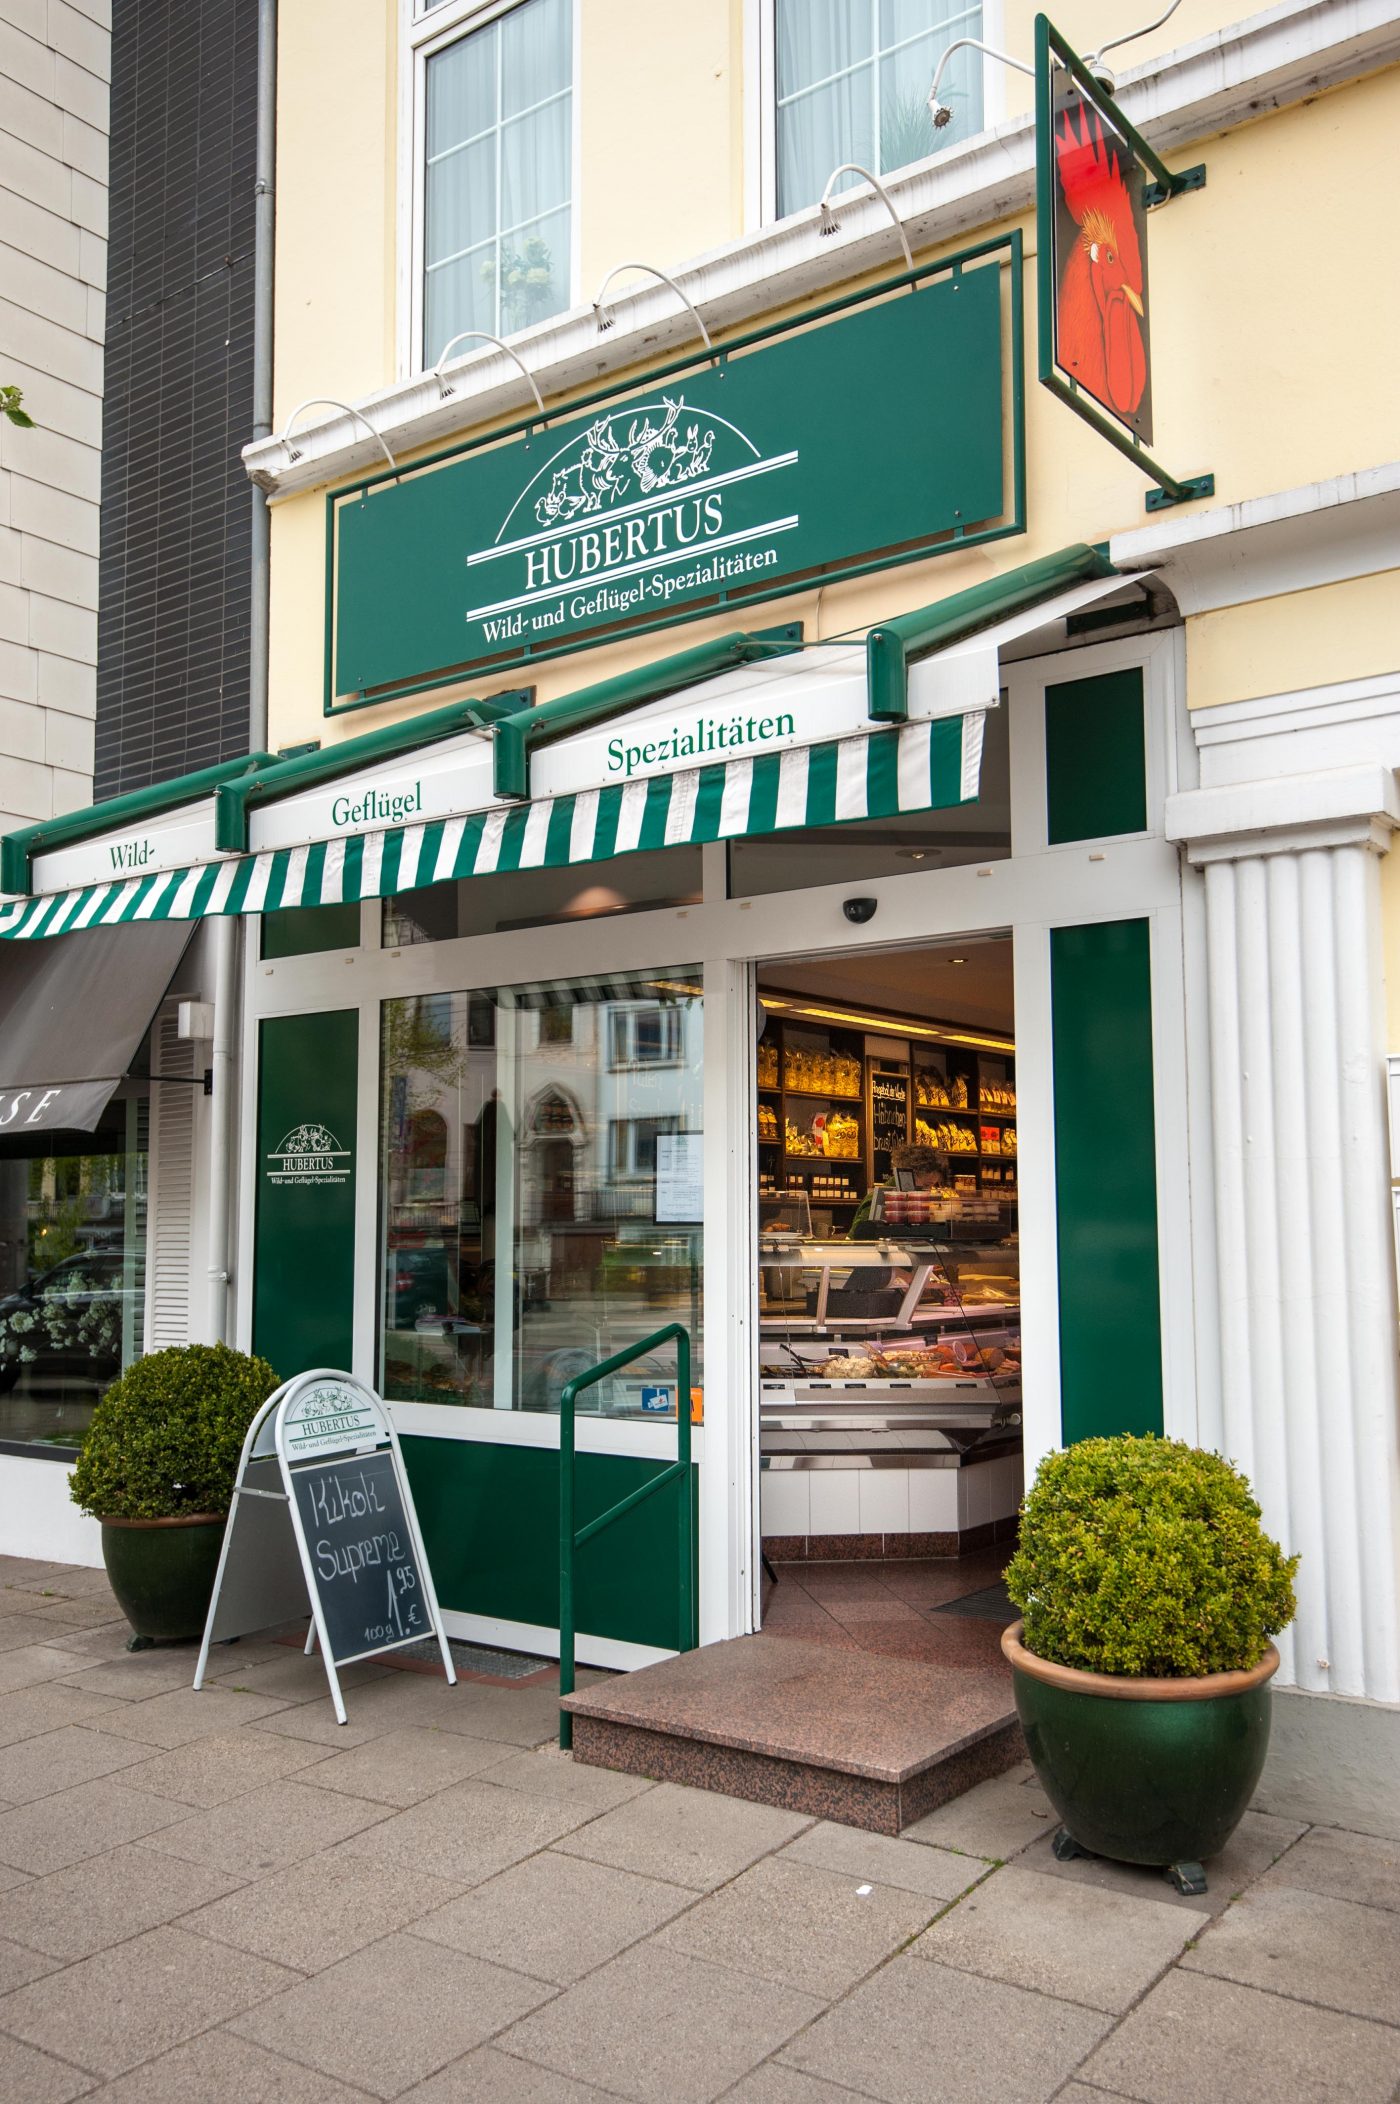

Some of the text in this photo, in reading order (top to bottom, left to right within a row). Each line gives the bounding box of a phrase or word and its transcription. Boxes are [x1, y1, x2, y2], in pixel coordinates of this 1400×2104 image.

[525, 493, 723, 590] HUBERTUS
[482, 549, 779, 643] Wild- und Geflügel-Spezialitäten
[607, 712, 795, 777] Spezialitäten
[332, 781, 423, 826] Geflügel
[110, 840, 156, 871] Wild-
[0, 1089, 62, 1126] SE
[283, 1157, 333, 1170] HUBERTUS
[302, 1415, 360, 1435] HUBERTUS
[308, 1471, 386, 1528] Kikok
[316, 1529, 406, 1584] Supreme
